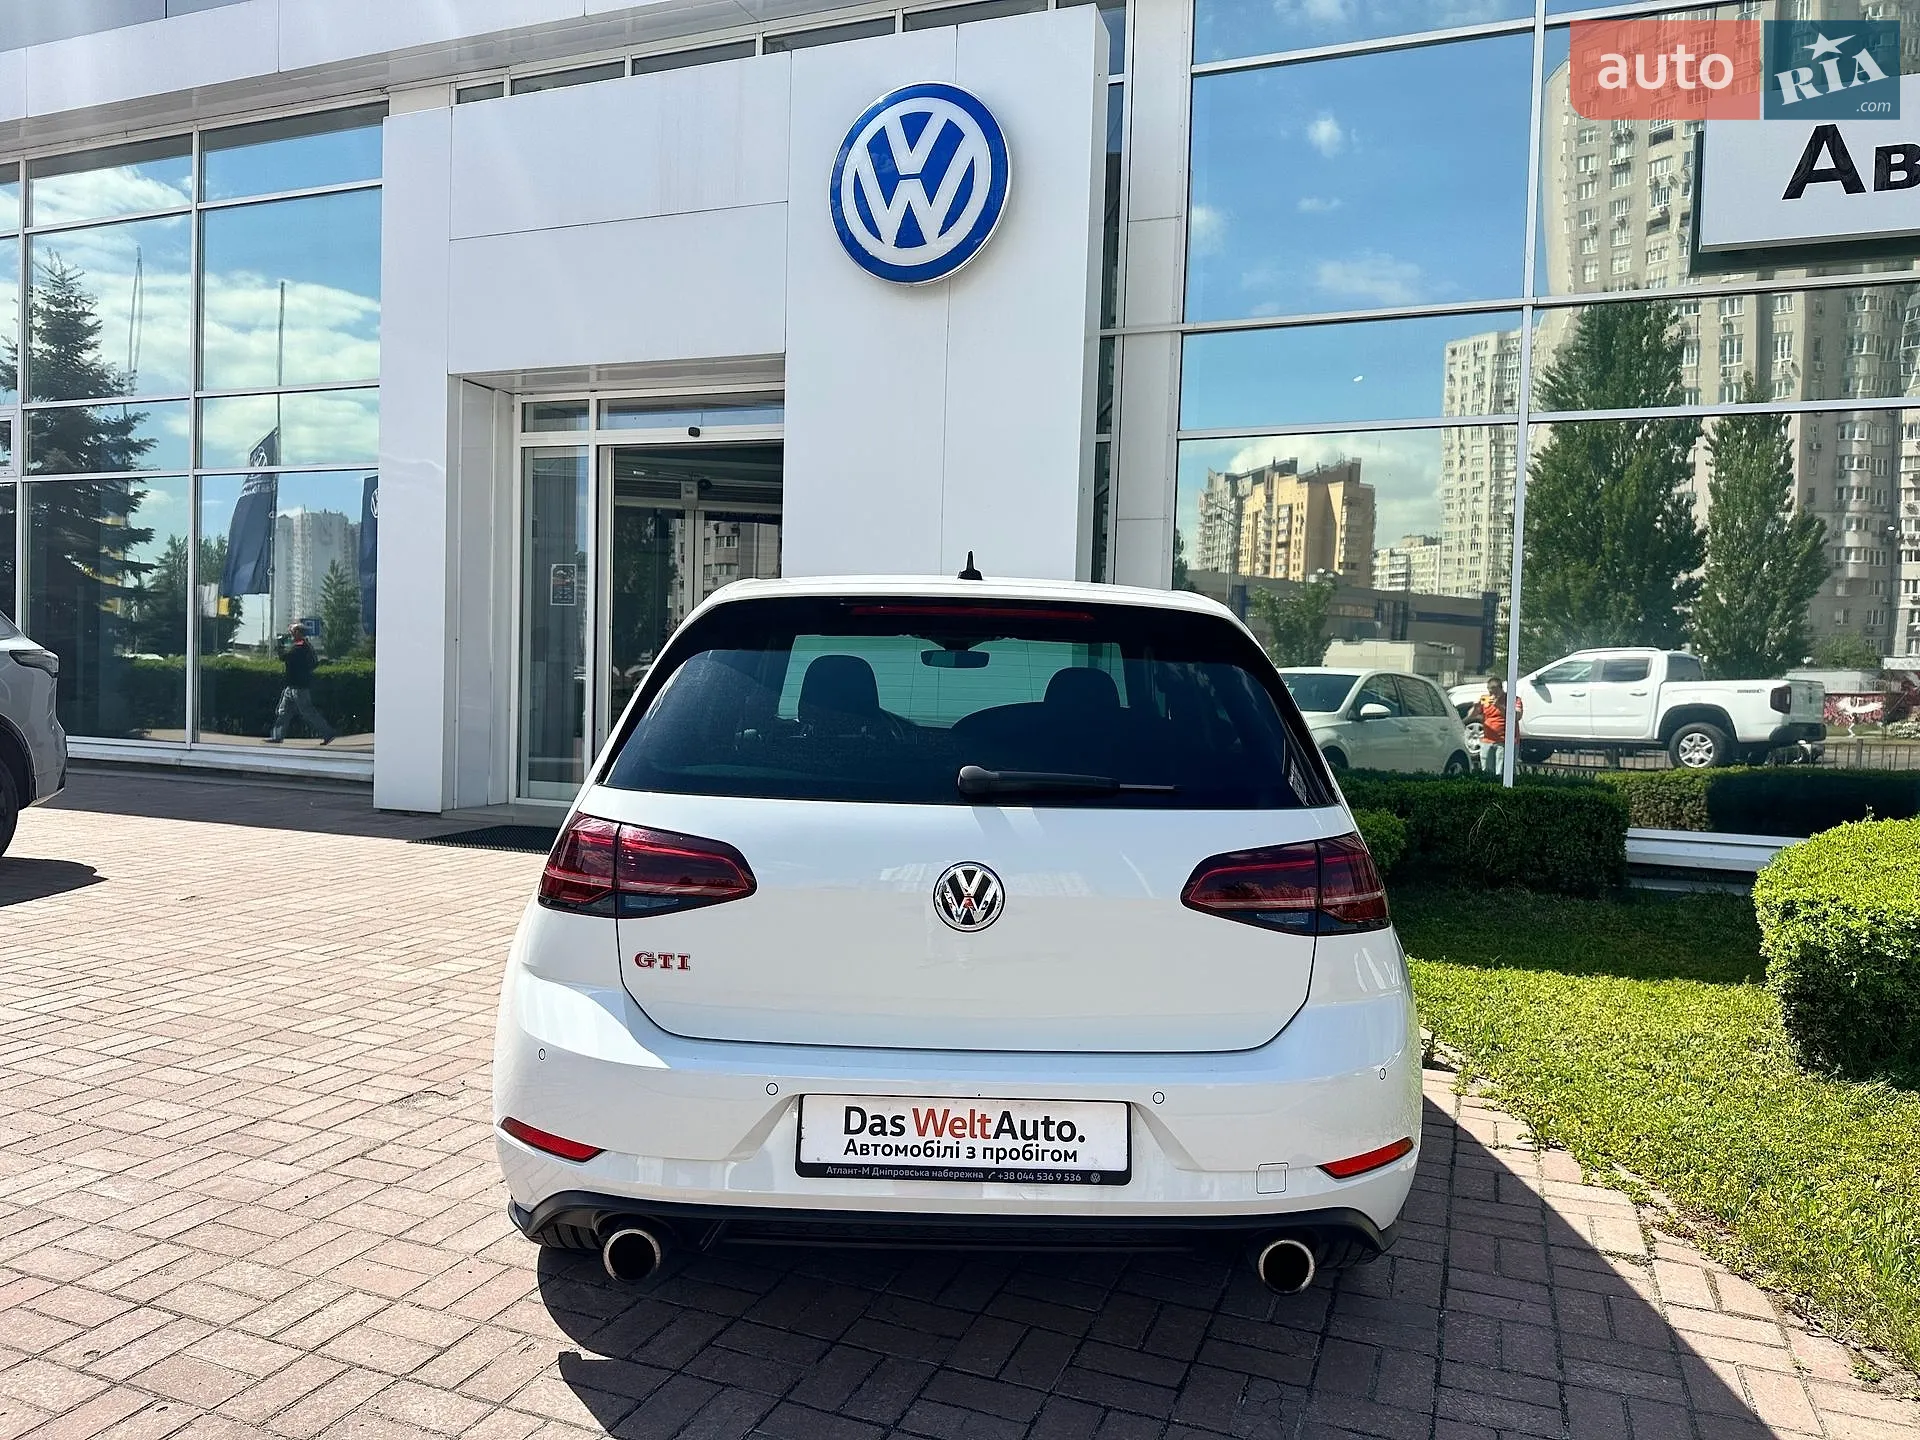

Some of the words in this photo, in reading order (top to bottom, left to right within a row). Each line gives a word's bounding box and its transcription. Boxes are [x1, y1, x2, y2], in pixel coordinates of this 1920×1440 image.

[633, 951, 691, 971] GTI
[844, 1105, 906, 1137] Das
[843, 1138, 960, 1159] Автомобілі
[966, 1146, 976, 1159] з
[982, 1143, 1078, 1165] пробігом
[826, 1165, 870, 1175] Атлант-М
[871, 1166, 930, 1178] Дніпровська
[931, 1168, 984, 1180] набережна
[998, 1171, 1015, 1180] +38
[1017, 1171, 1034, 1181] 044
[1036, 1172, 1054, 1181] 536
[1055, 1172, 1062, 1181] 9
[1064, 1173, 1081, 1182] 536
